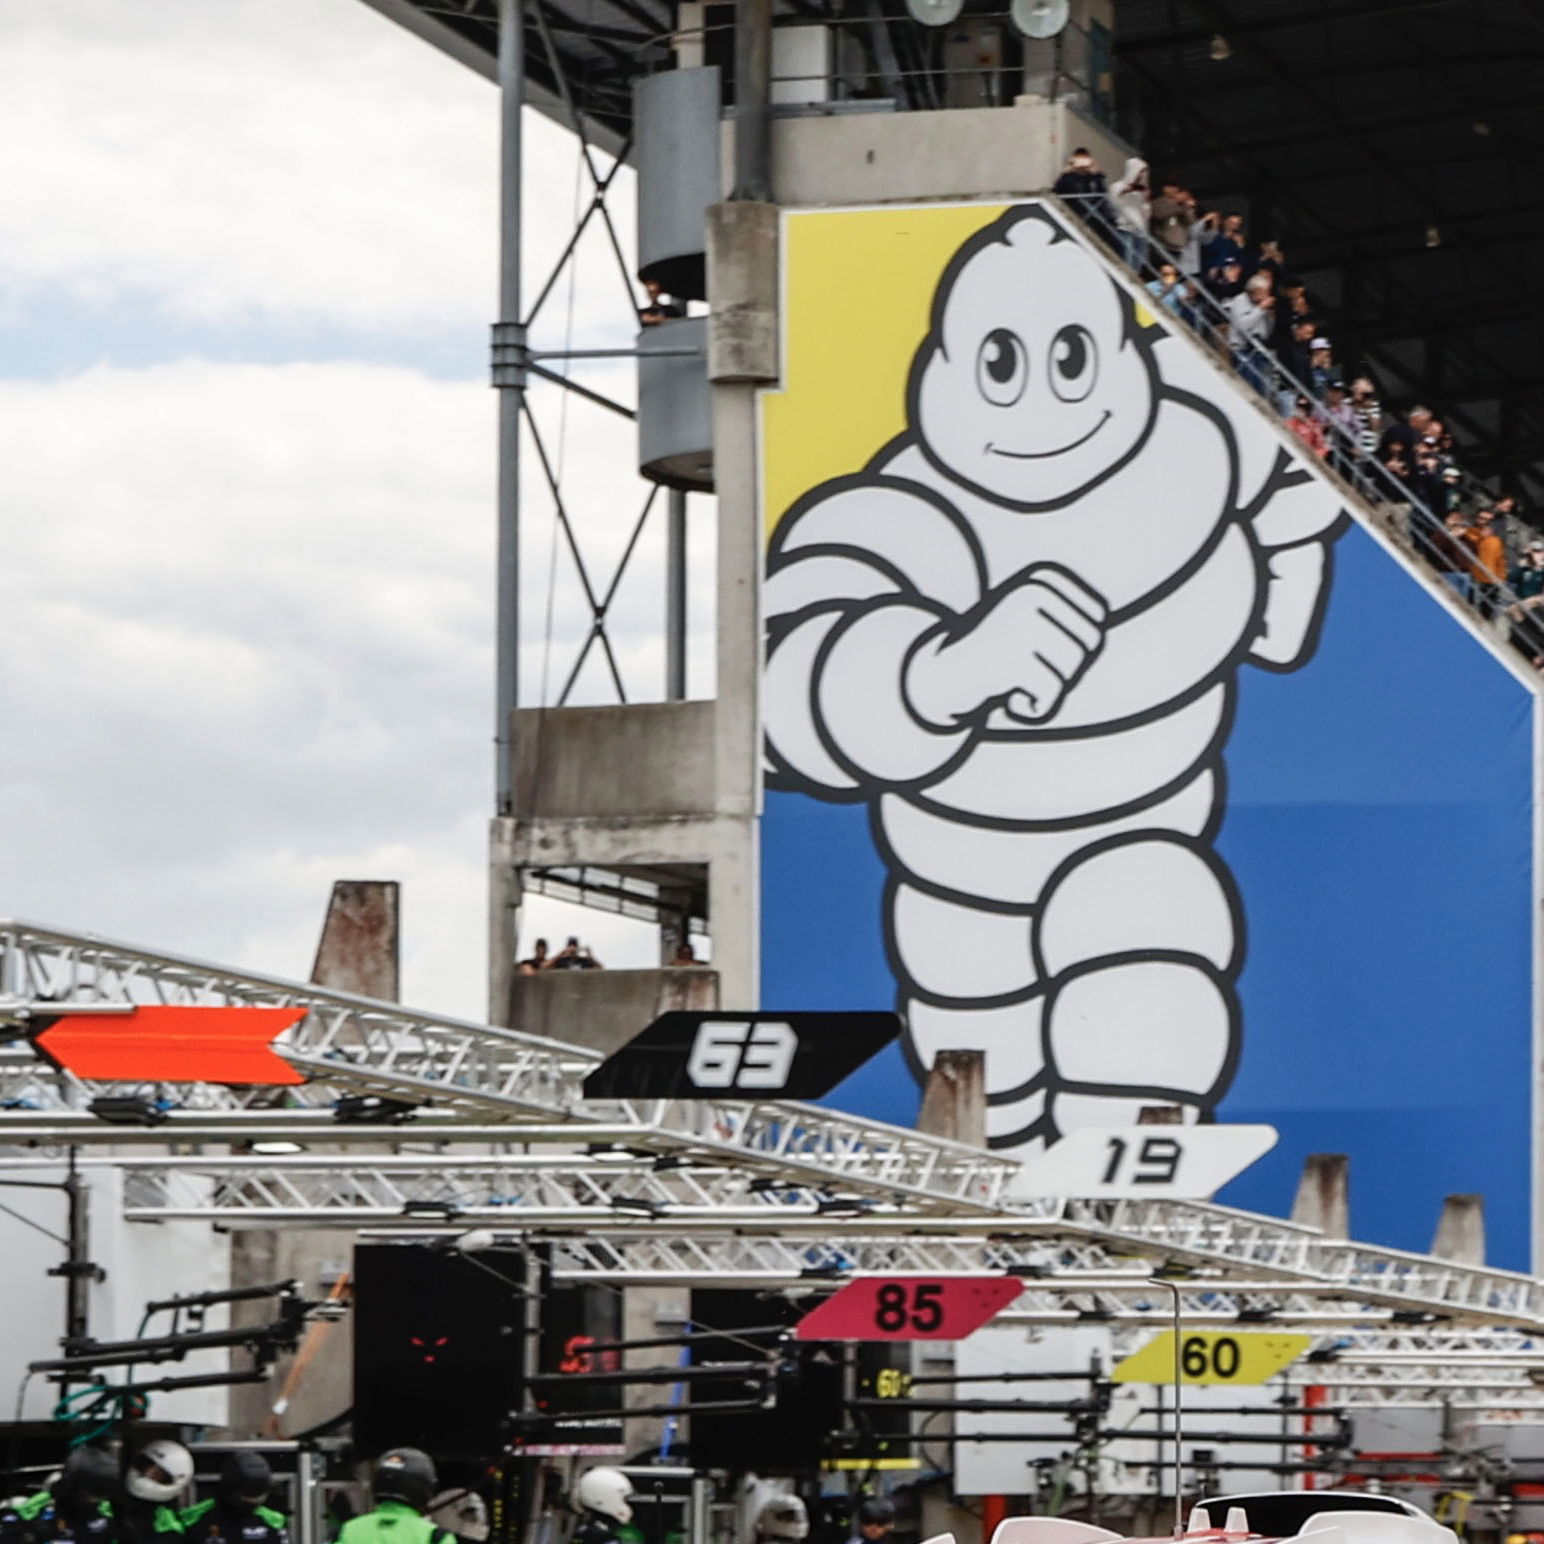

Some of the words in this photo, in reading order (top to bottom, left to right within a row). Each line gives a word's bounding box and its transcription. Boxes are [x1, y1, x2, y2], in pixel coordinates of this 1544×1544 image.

[687, 1021, 798, 1089] 63
[1101, 1137, 1184, 1184] 19
[875, 1284, 943, 1332] 85
[1181, 1337, 1241, 1379] 60
